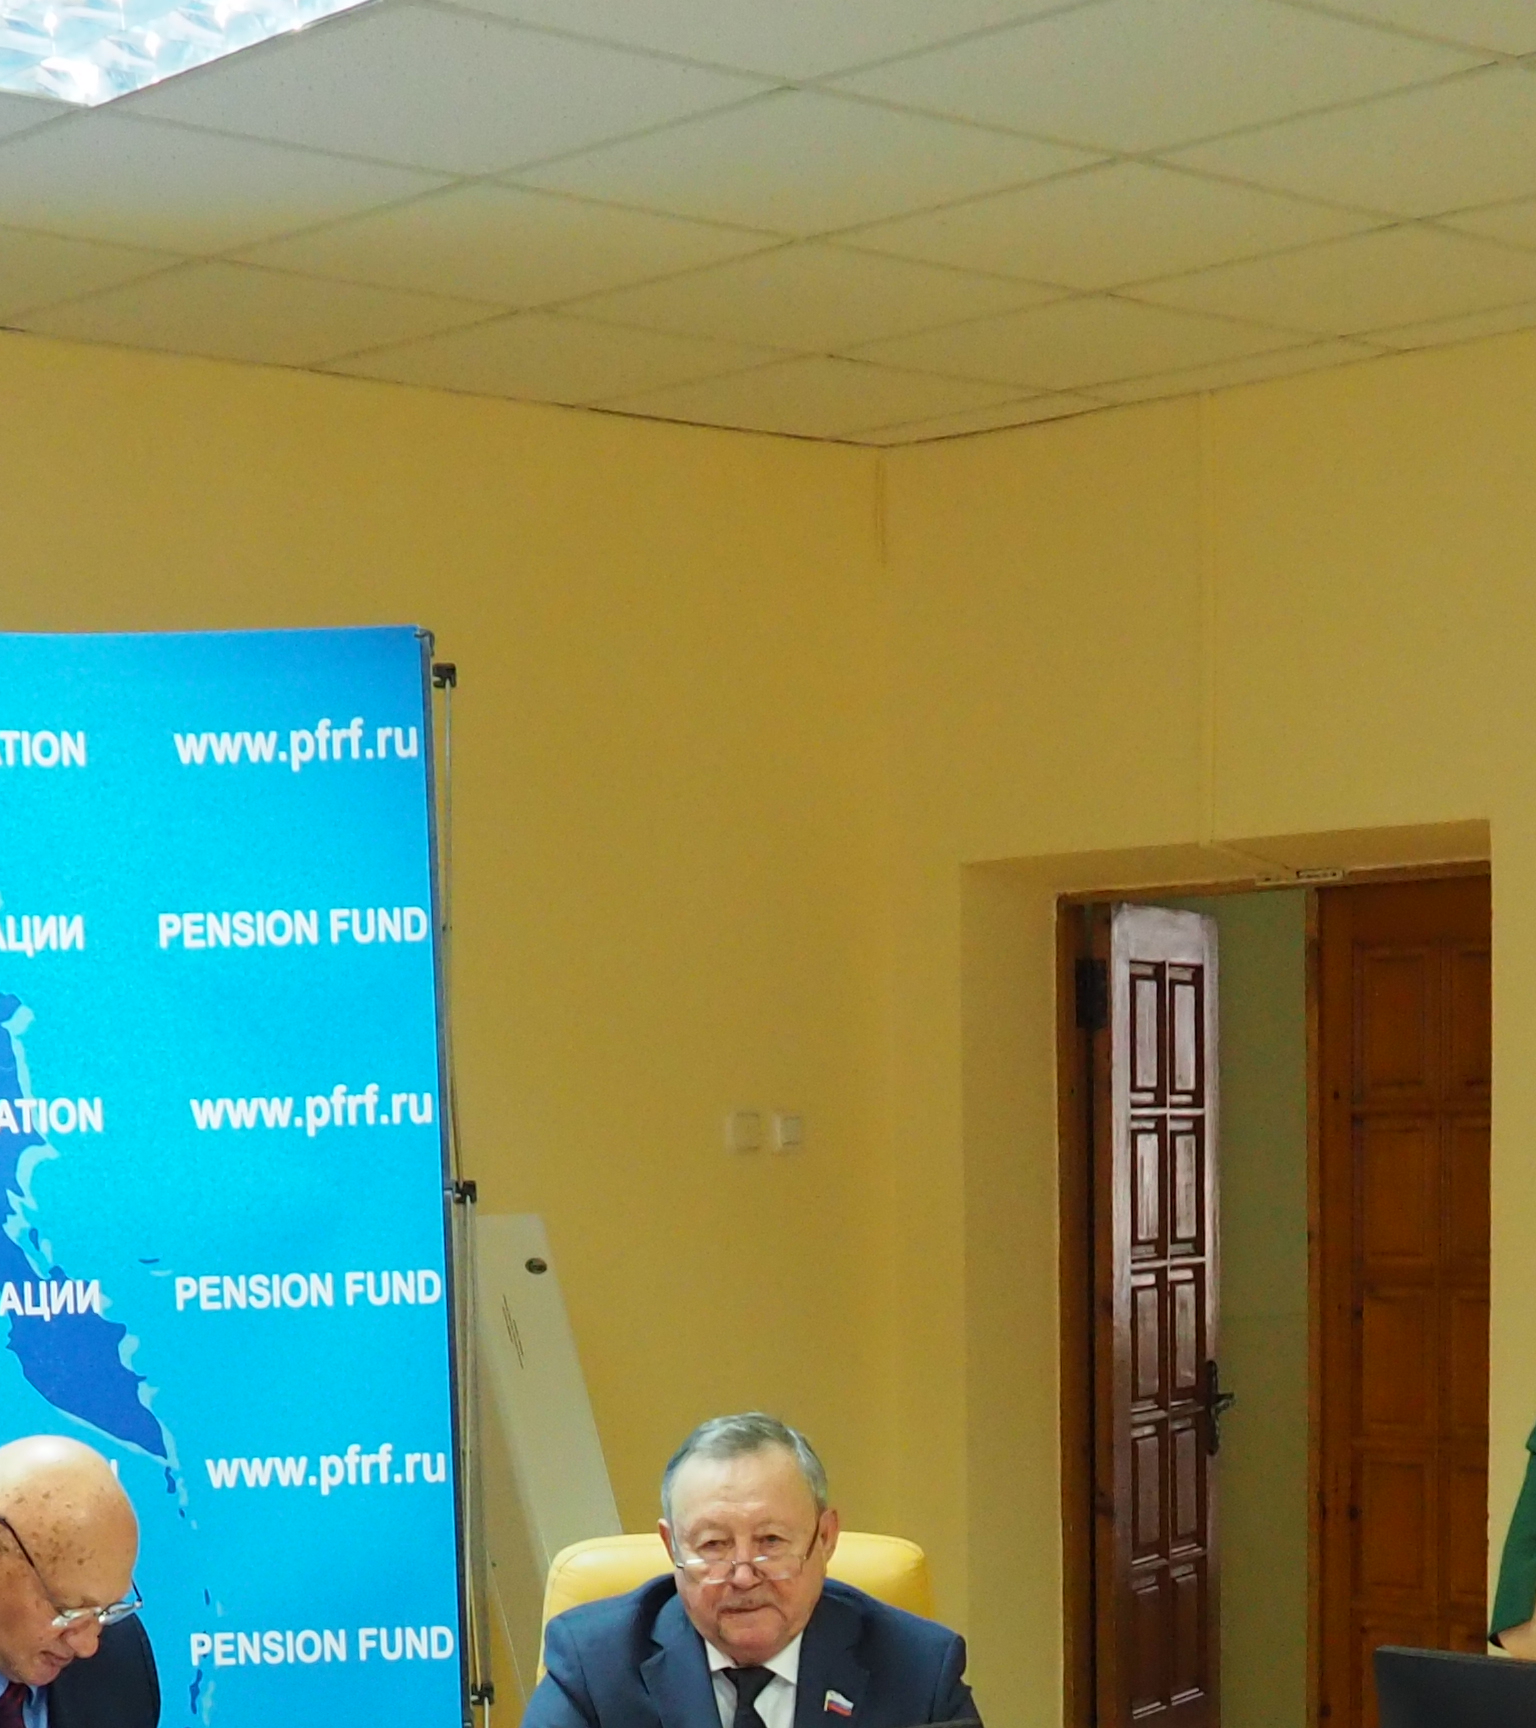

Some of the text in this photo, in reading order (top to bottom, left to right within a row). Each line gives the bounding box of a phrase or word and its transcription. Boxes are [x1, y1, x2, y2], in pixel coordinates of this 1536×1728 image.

[173, 717, 419, 772] www.pfrf.ru
[158, 905, 428, 949] PENSION FUND
[190, 1083, 433, 1136] www.pfrf.ru
[175, 1268, 442, 1311] PENSION FUND
[205, 1443, 447, 1496] www.pfrf.ru
[190, 1625, 455, 1666] PENSION FUND
